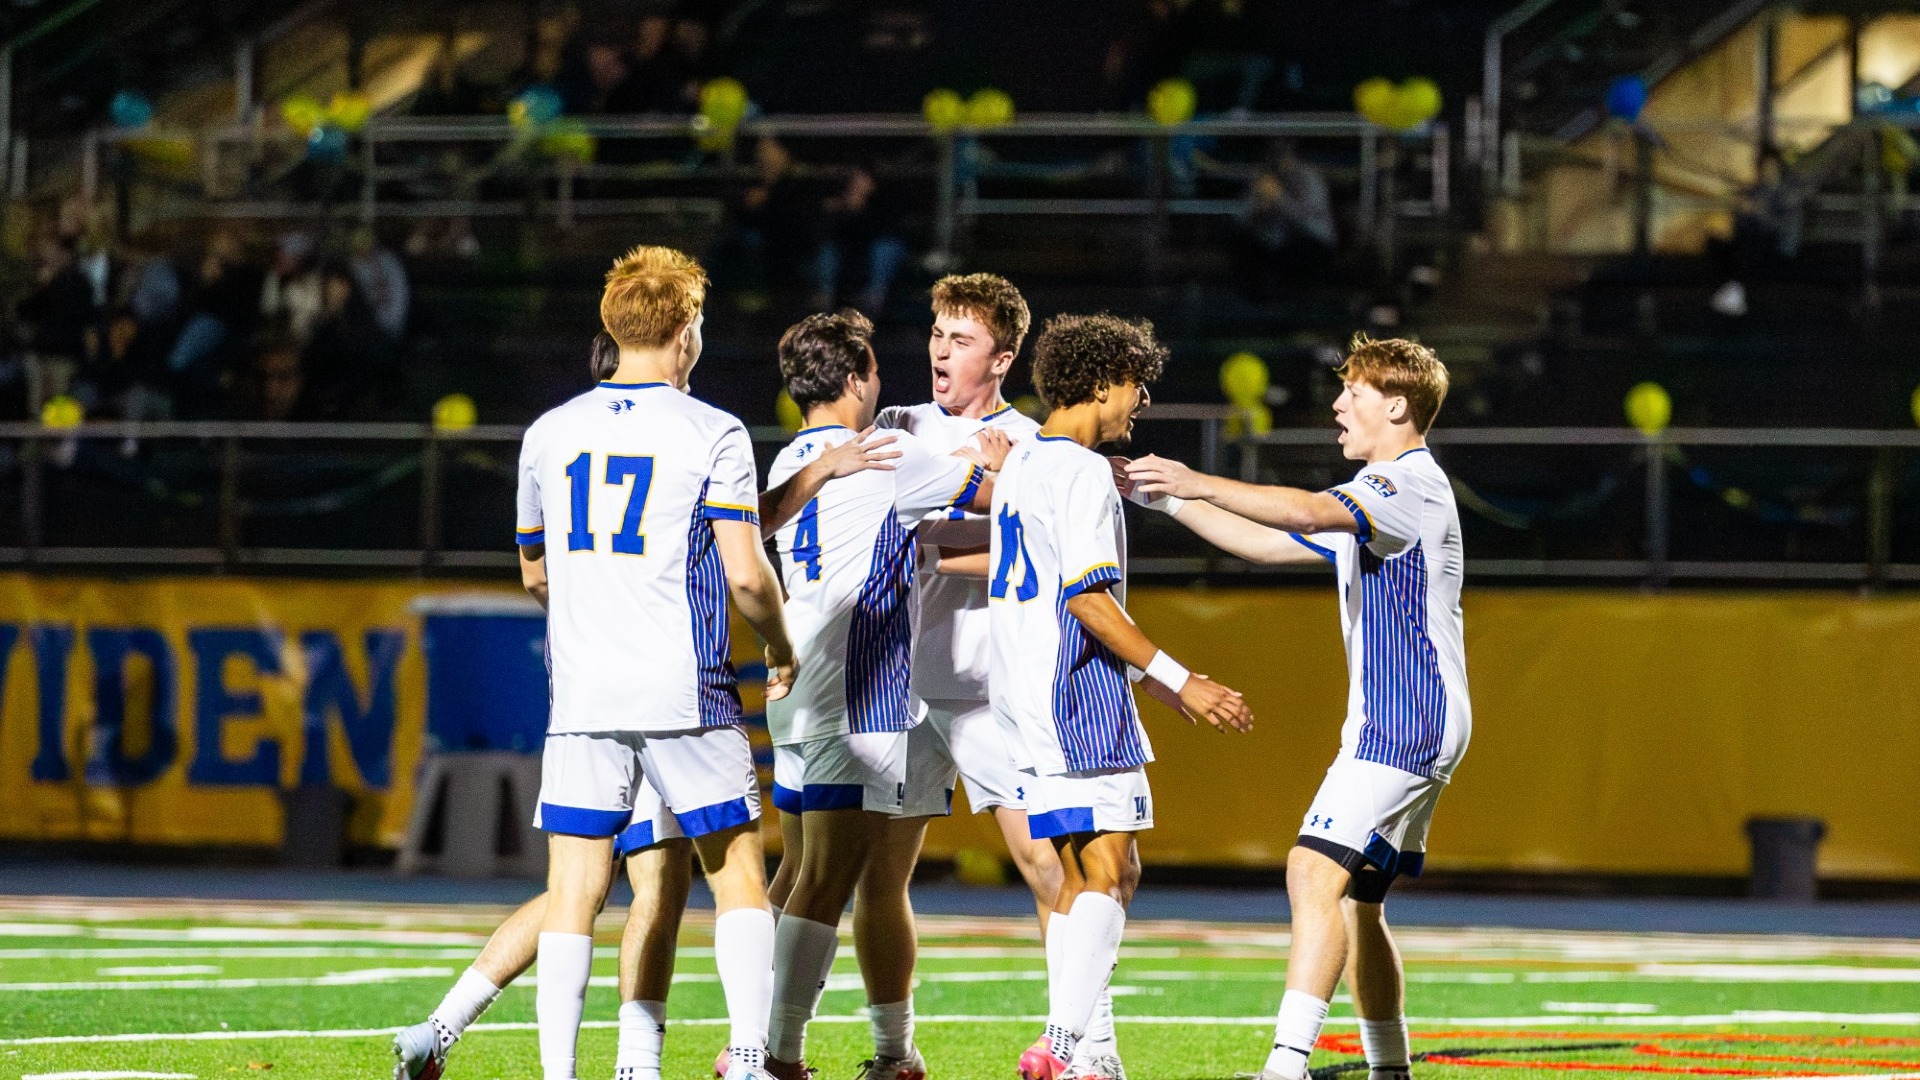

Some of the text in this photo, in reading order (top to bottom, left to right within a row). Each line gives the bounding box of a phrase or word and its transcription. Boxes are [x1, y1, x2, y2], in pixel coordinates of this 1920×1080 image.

[565, 451, 656, 557] 17
[793, 495, 822, 582] 4
[0, 624, 406, 790] IDEN
